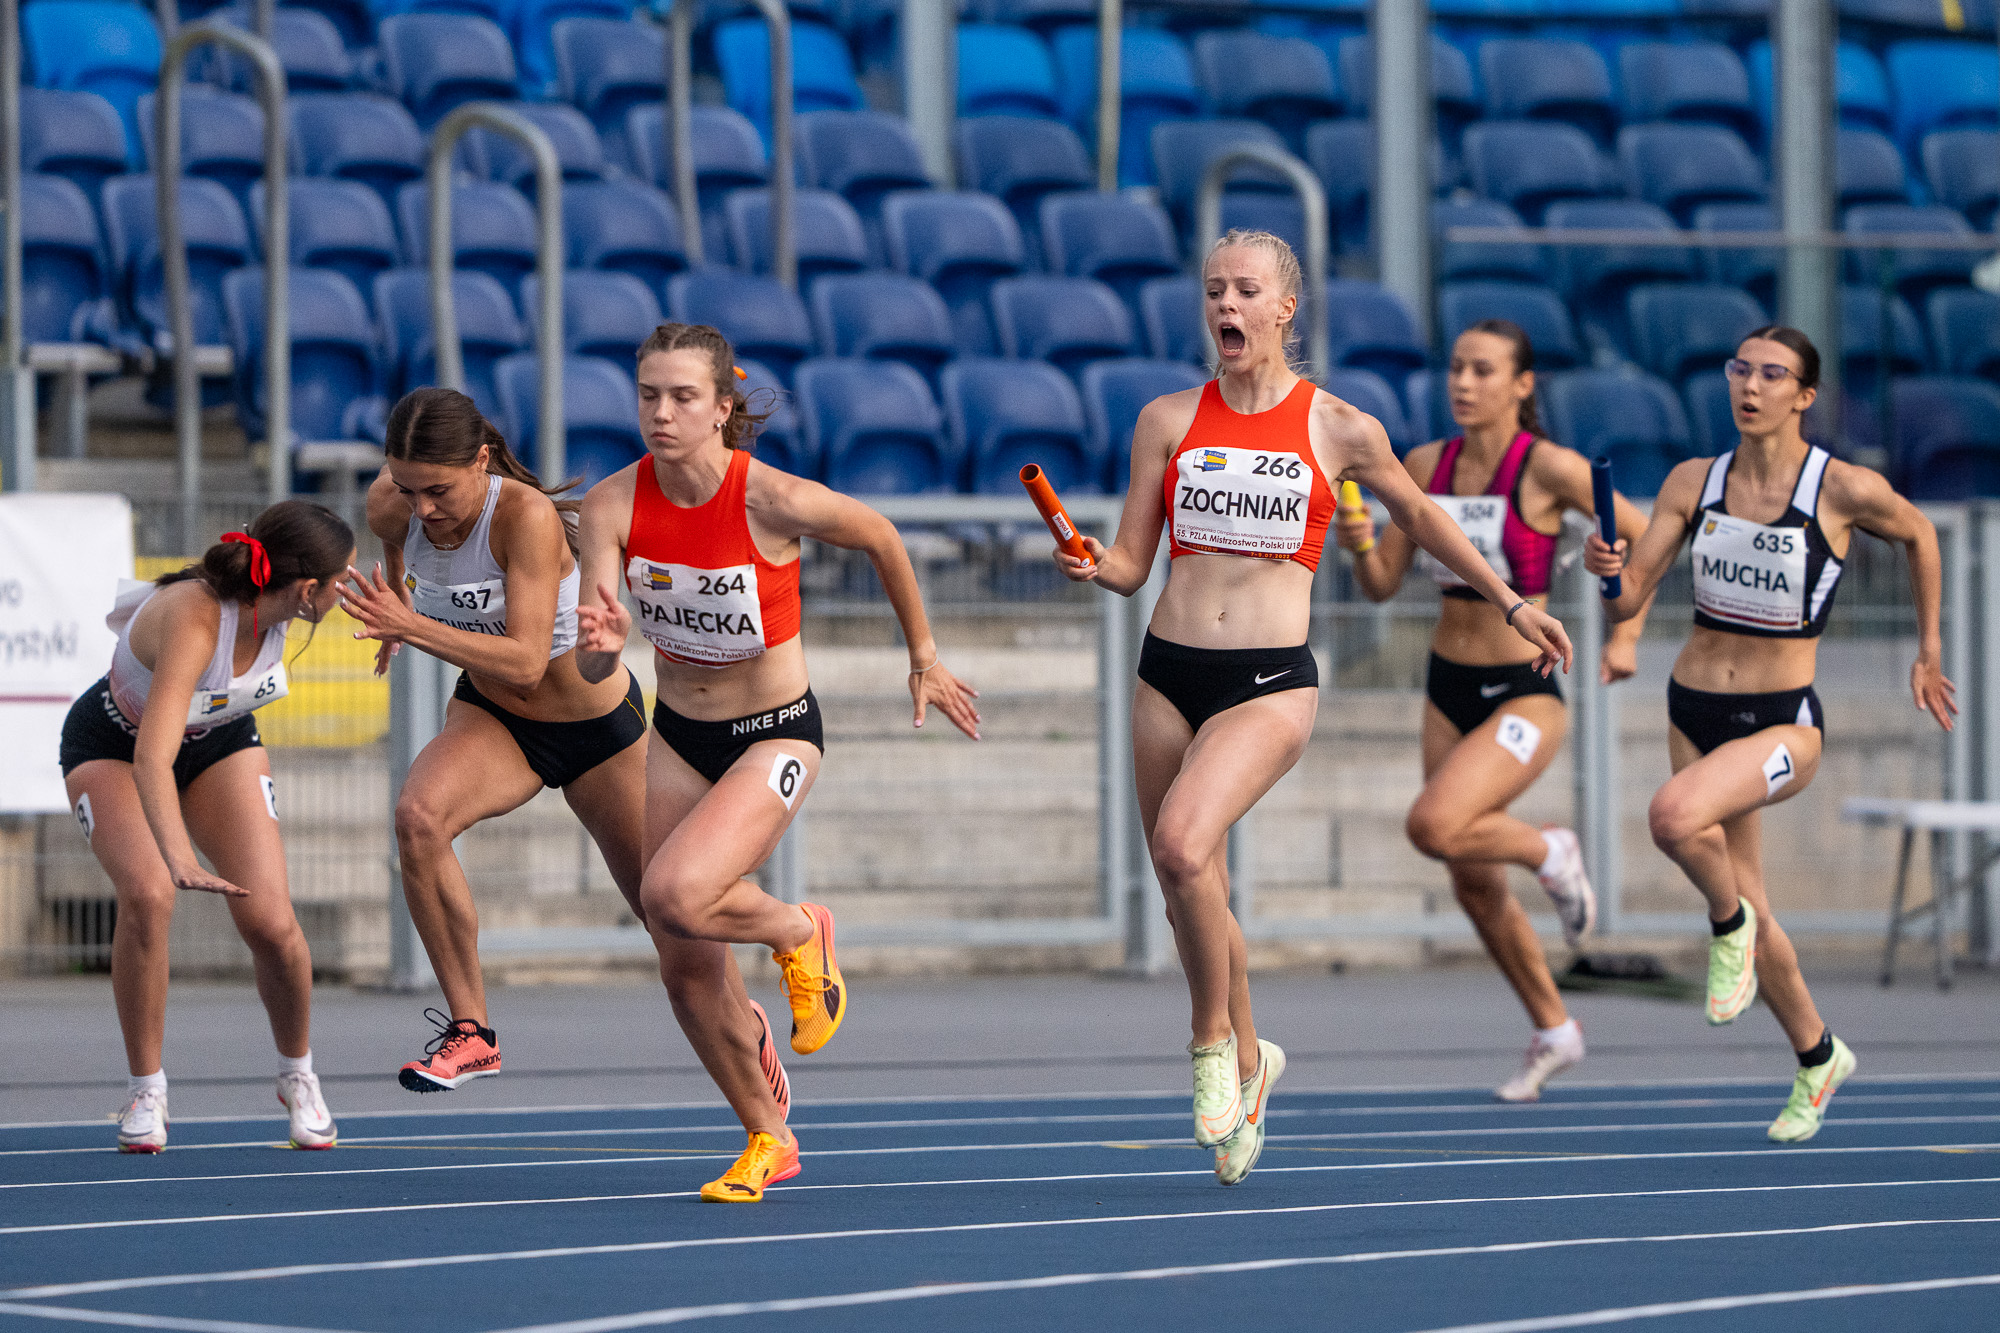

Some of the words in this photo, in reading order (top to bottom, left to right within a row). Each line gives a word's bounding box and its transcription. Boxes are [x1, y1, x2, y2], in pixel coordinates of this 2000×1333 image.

[1252, 455, 1300, 479] 266
[1180, 485, 1301, 522] ZOCHNIAK
[1176, 529, 1188, 538] 55.
[1190, 531, 1208, 541] PZLA
[1209, 535, 1258, 547] Mistrzostwa
[1260, 540, 1285, 550] Polski
[1287, 541, 1301, 550] U18
[1753, 531, 1794, 554] 635
[698, 573, 746, 595] 264
[1702, 555, 1790, 593] MUCHA
[451, 588, 492, 610] 637
[638, 599, 757, 635] PAJĘCKA
[655, 637, 673, 649] PZLA
[674, 643, 720, 659] Mistrzostwa
[254, 675, 276, 699] 65
[732, 713, 774, 736] NIKE
[778, 699, 808, 725] PRO
[779, 759, 801, 799] 6
[1770, 754, 1791, 782] 7
